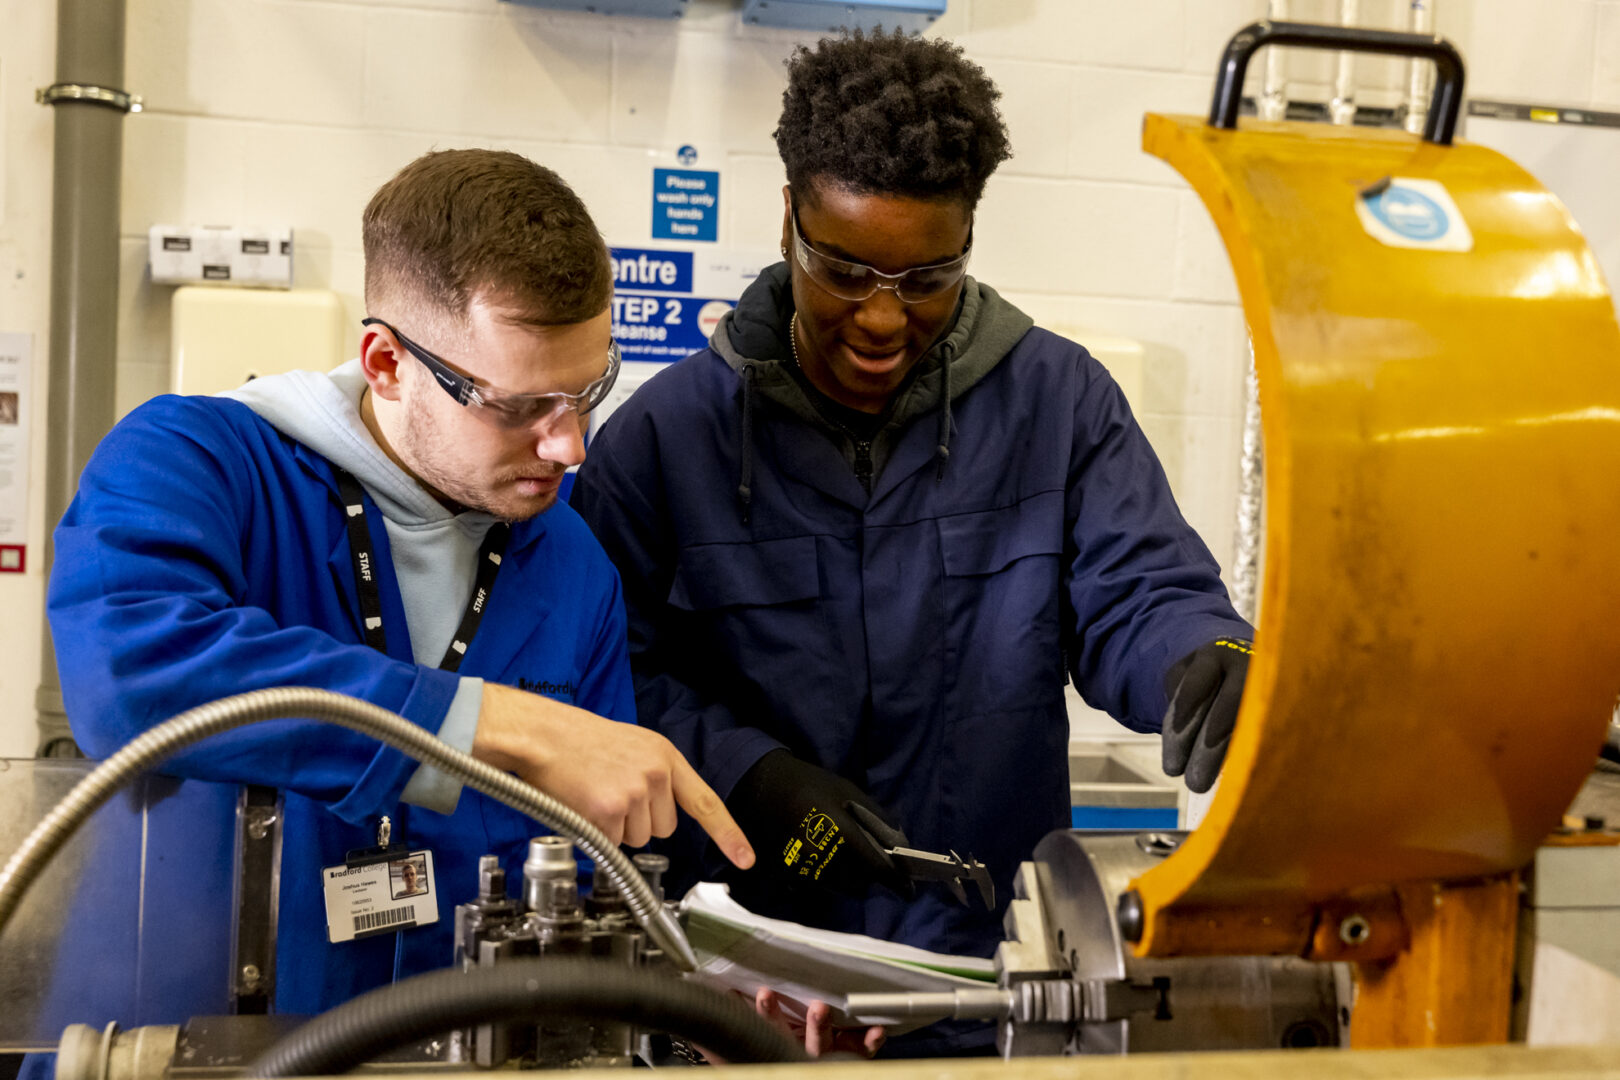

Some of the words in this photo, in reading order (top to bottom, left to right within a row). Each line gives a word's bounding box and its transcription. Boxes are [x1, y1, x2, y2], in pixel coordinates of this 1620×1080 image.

[666, 175, 706, 190] Please
[656, 191, 689, 204] wash
[689, 194, 715, 207] only
[666, 207, 703, 221] hands
[671, 221, 699, 235] here
[664, 300, 683, 326] 2
[359, 552, 372, 581] STAFF
[473, 587, 487, 613] STAFF
[363, 863, 388, 874] College
